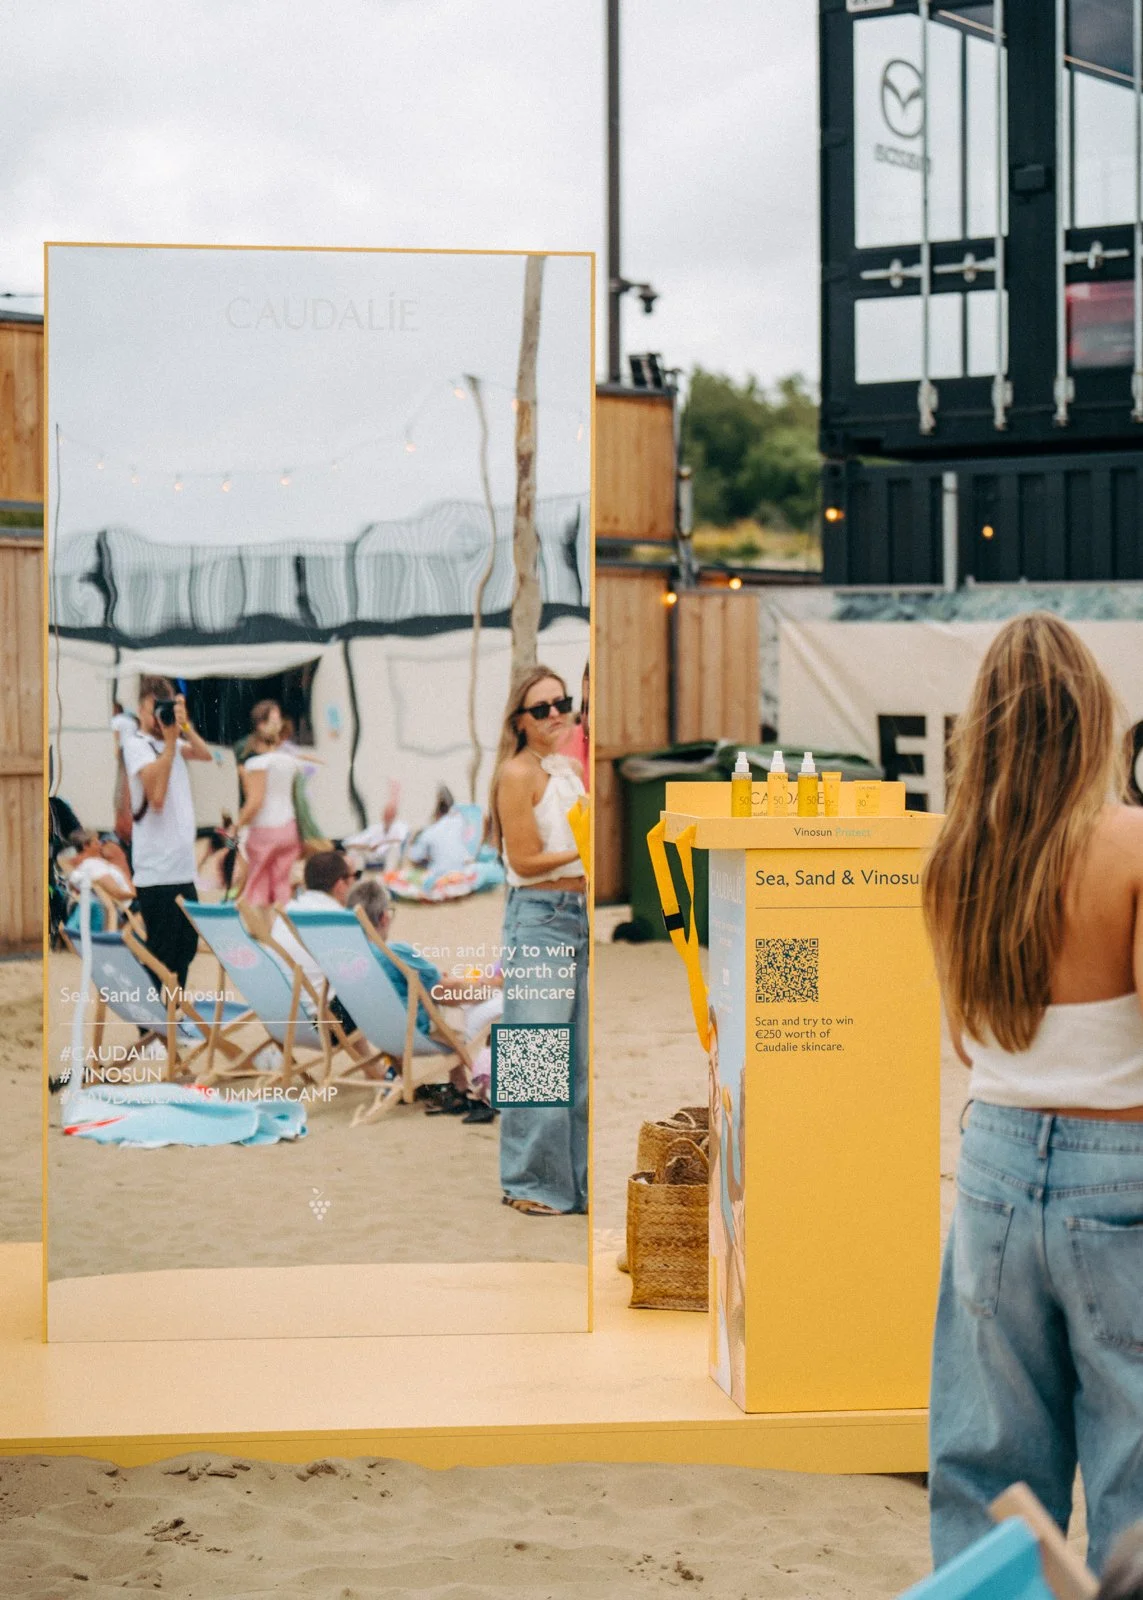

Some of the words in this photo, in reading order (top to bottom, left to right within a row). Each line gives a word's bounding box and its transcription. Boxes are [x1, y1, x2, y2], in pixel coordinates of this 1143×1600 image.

[794, 827, 833, 838] Vinosun
[835, 827, 872, 838] Protect
[755, 869, 790, 887] Sea,
[795, 869, 836, 886] Sand
[841, 869, 855, 886] &
[861, 868, 920, 885] Vinosu
[411, 942, 451, 958] Scan
[456, 943, 486, 958] and
[492, 944, 517, 961] try
[522, 945, 541, 958] to
[546, 944, 576, 957] win
[452, 963, 496, 979] €250
[501, 963, 552, 979] worth
[558, 963, 577, 979] of
[100, 986, 140, 1003] Sand
[146, 987, 161, 1002] &
[165, 986, 235, 1002] Vinosun
[430, 985, 504, 1001] Caudalie
[507, 984, 576, 1000] skincare
[755, 1016, 779, 1027] Scan
[781, 1016, 800, 1027] and
[803, 1017, 818, 1028] try
[821, 1017, 833, 1026] to
[836, 1016, 854, 1026] win
[755, 1029, 781, 1040] €250
[784, 1029, 816, 1039] worth
[819, 1029, 831, 1039] of
[755, 1042, 798, 1053] Caudalie
[801, 1041, 845, 1052] skincare.
